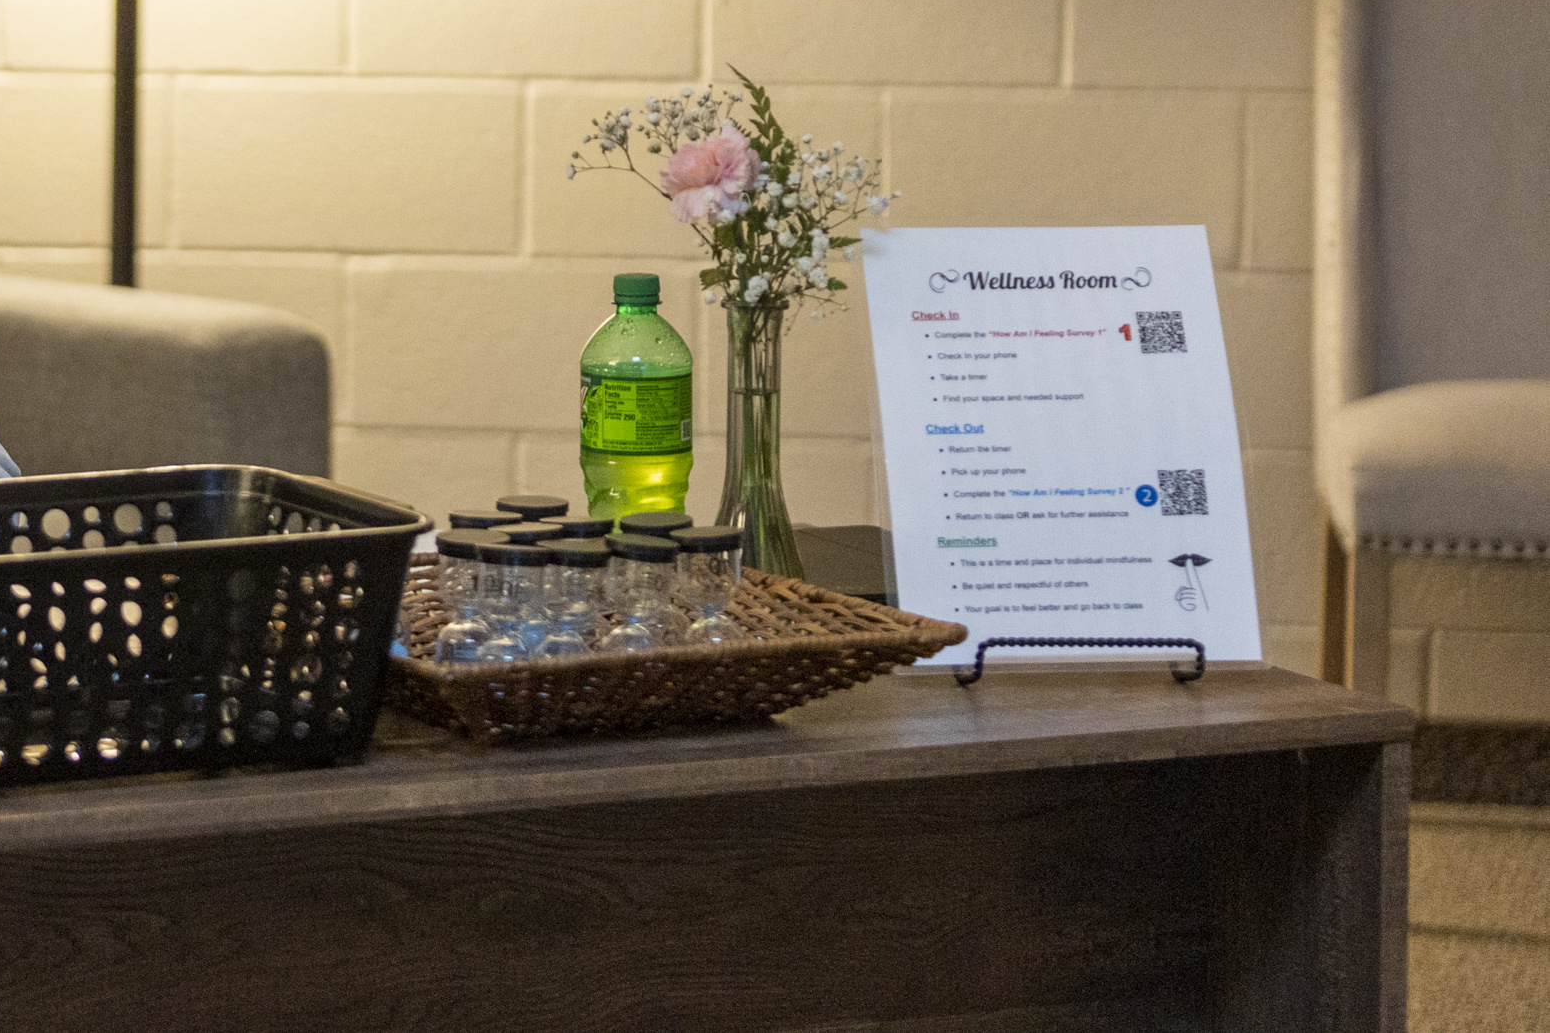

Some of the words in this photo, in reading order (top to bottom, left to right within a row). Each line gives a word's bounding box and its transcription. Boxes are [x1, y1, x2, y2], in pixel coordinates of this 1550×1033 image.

[963, 270, 1055, 290] Wellness
[1059, 270, 1117, 289] Room
[911, 310, 946, 321] Check
[934, 331, 972, 339] Complete
[1034, 329, 1064, 338] Feeling
[1067, 329, 1095, 337] Survey
[1118, 323, 1132, 342] 1
[937, 352, 962, 360] Check
[993, 352, 1017, 360] phone
[943, 394, 960, 402] Find
[1055, 393, 1084, 401] support
[925, 424, 961, 435] Check
[963, 423, 985, 434] Out
[953, 490, 990, 498] Complete
[1142, 489, 1152, 503] 2
[937, 536, 998, 548] Reminders
